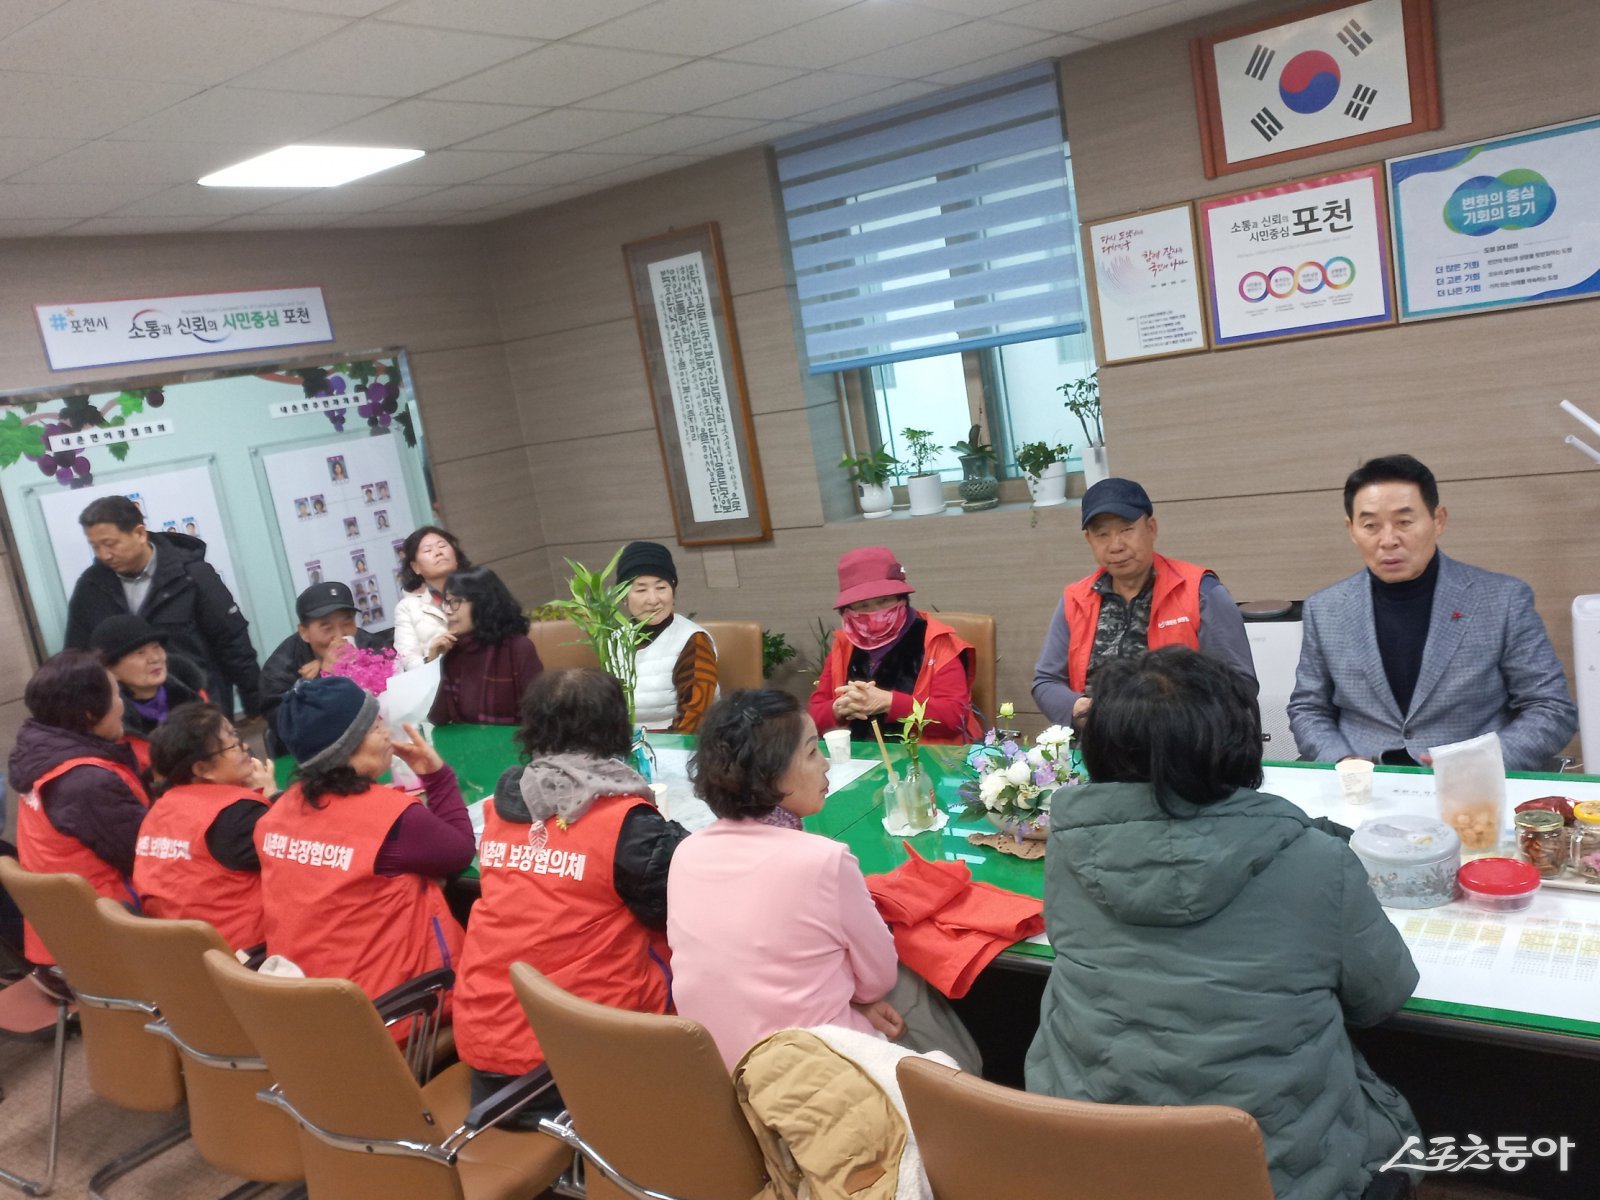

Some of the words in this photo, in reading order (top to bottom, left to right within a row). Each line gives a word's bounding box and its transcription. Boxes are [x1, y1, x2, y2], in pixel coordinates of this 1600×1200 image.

[1462, 191, 1503, 210] 변화의
[1506, 186, 1535, 203] 중심
[1231, 219, 1259, 234] 소통과
[1261, 213, 1289, 228] 신뢰의
[1291, 198, 1354, 237] 포천
[1463, 207, 1504, 225] 기회의
[1508, 202, 1535, 217] 경기
[1249, 226, 1290, 243] 시민중심
[1436, 266, 1444, 274] 더
[1446, 263, 1461, 273] 많은
[1463, 260, 1480, 270] 기회
[1436, 278, 1444, 286] 더
[1464, 272, 1480, 282] 기회
[1437, 289, 1445, 297] 더
[1447, 287, 1463, 296] 나은
[1465, 284, 1481, 294] 기회
[70, 316, 109, 334] 포천시
[128, 319, 172, 340] 소통과
[177, 316, 218, 336] 신뢰의
[222, 310, 280, 331] 시민중심
[282, 308, 311, 325] 포천
[287, 838, 354, 872] 보장협의체
[507, 844, 587, 881] 보장협의체
